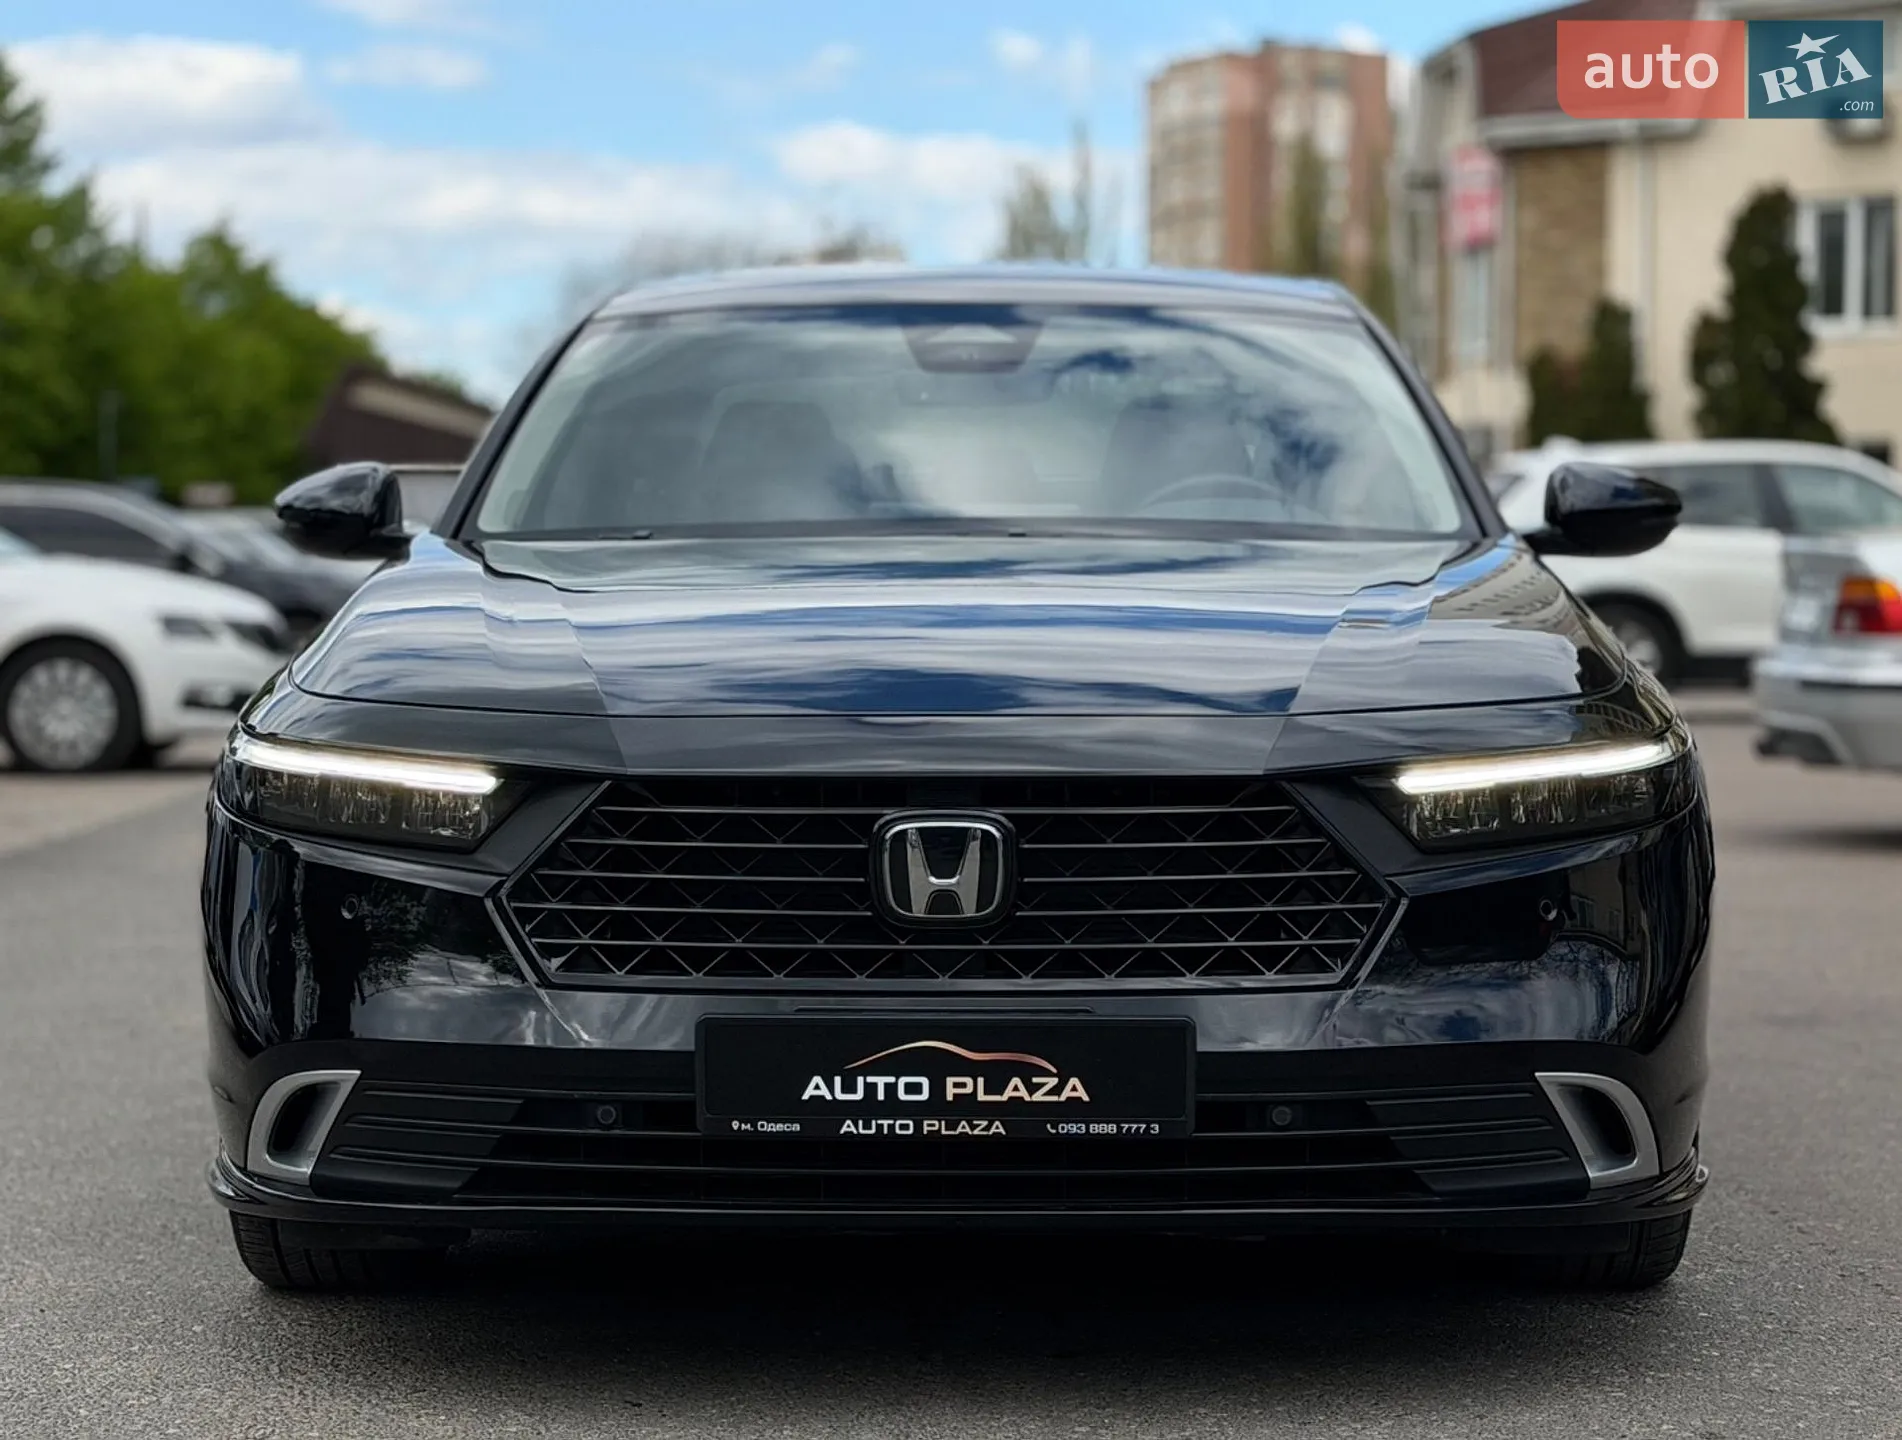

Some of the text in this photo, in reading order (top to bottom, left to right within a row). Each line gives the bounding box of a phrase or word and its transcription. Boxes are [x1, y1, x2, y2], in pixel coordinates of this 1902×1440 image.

[801, 1075, 1090, 1102] AUTO PLAZA
[741, 1120, 801, 1132] м. Одеса
[839, 1119, 1007, 1135] AUTO PLAZA
[1057, 1123, 1085, 1134] 093
[1089, 1123, 1117, 1134] 888
[1120, 1123, 1147, 1134] 777
